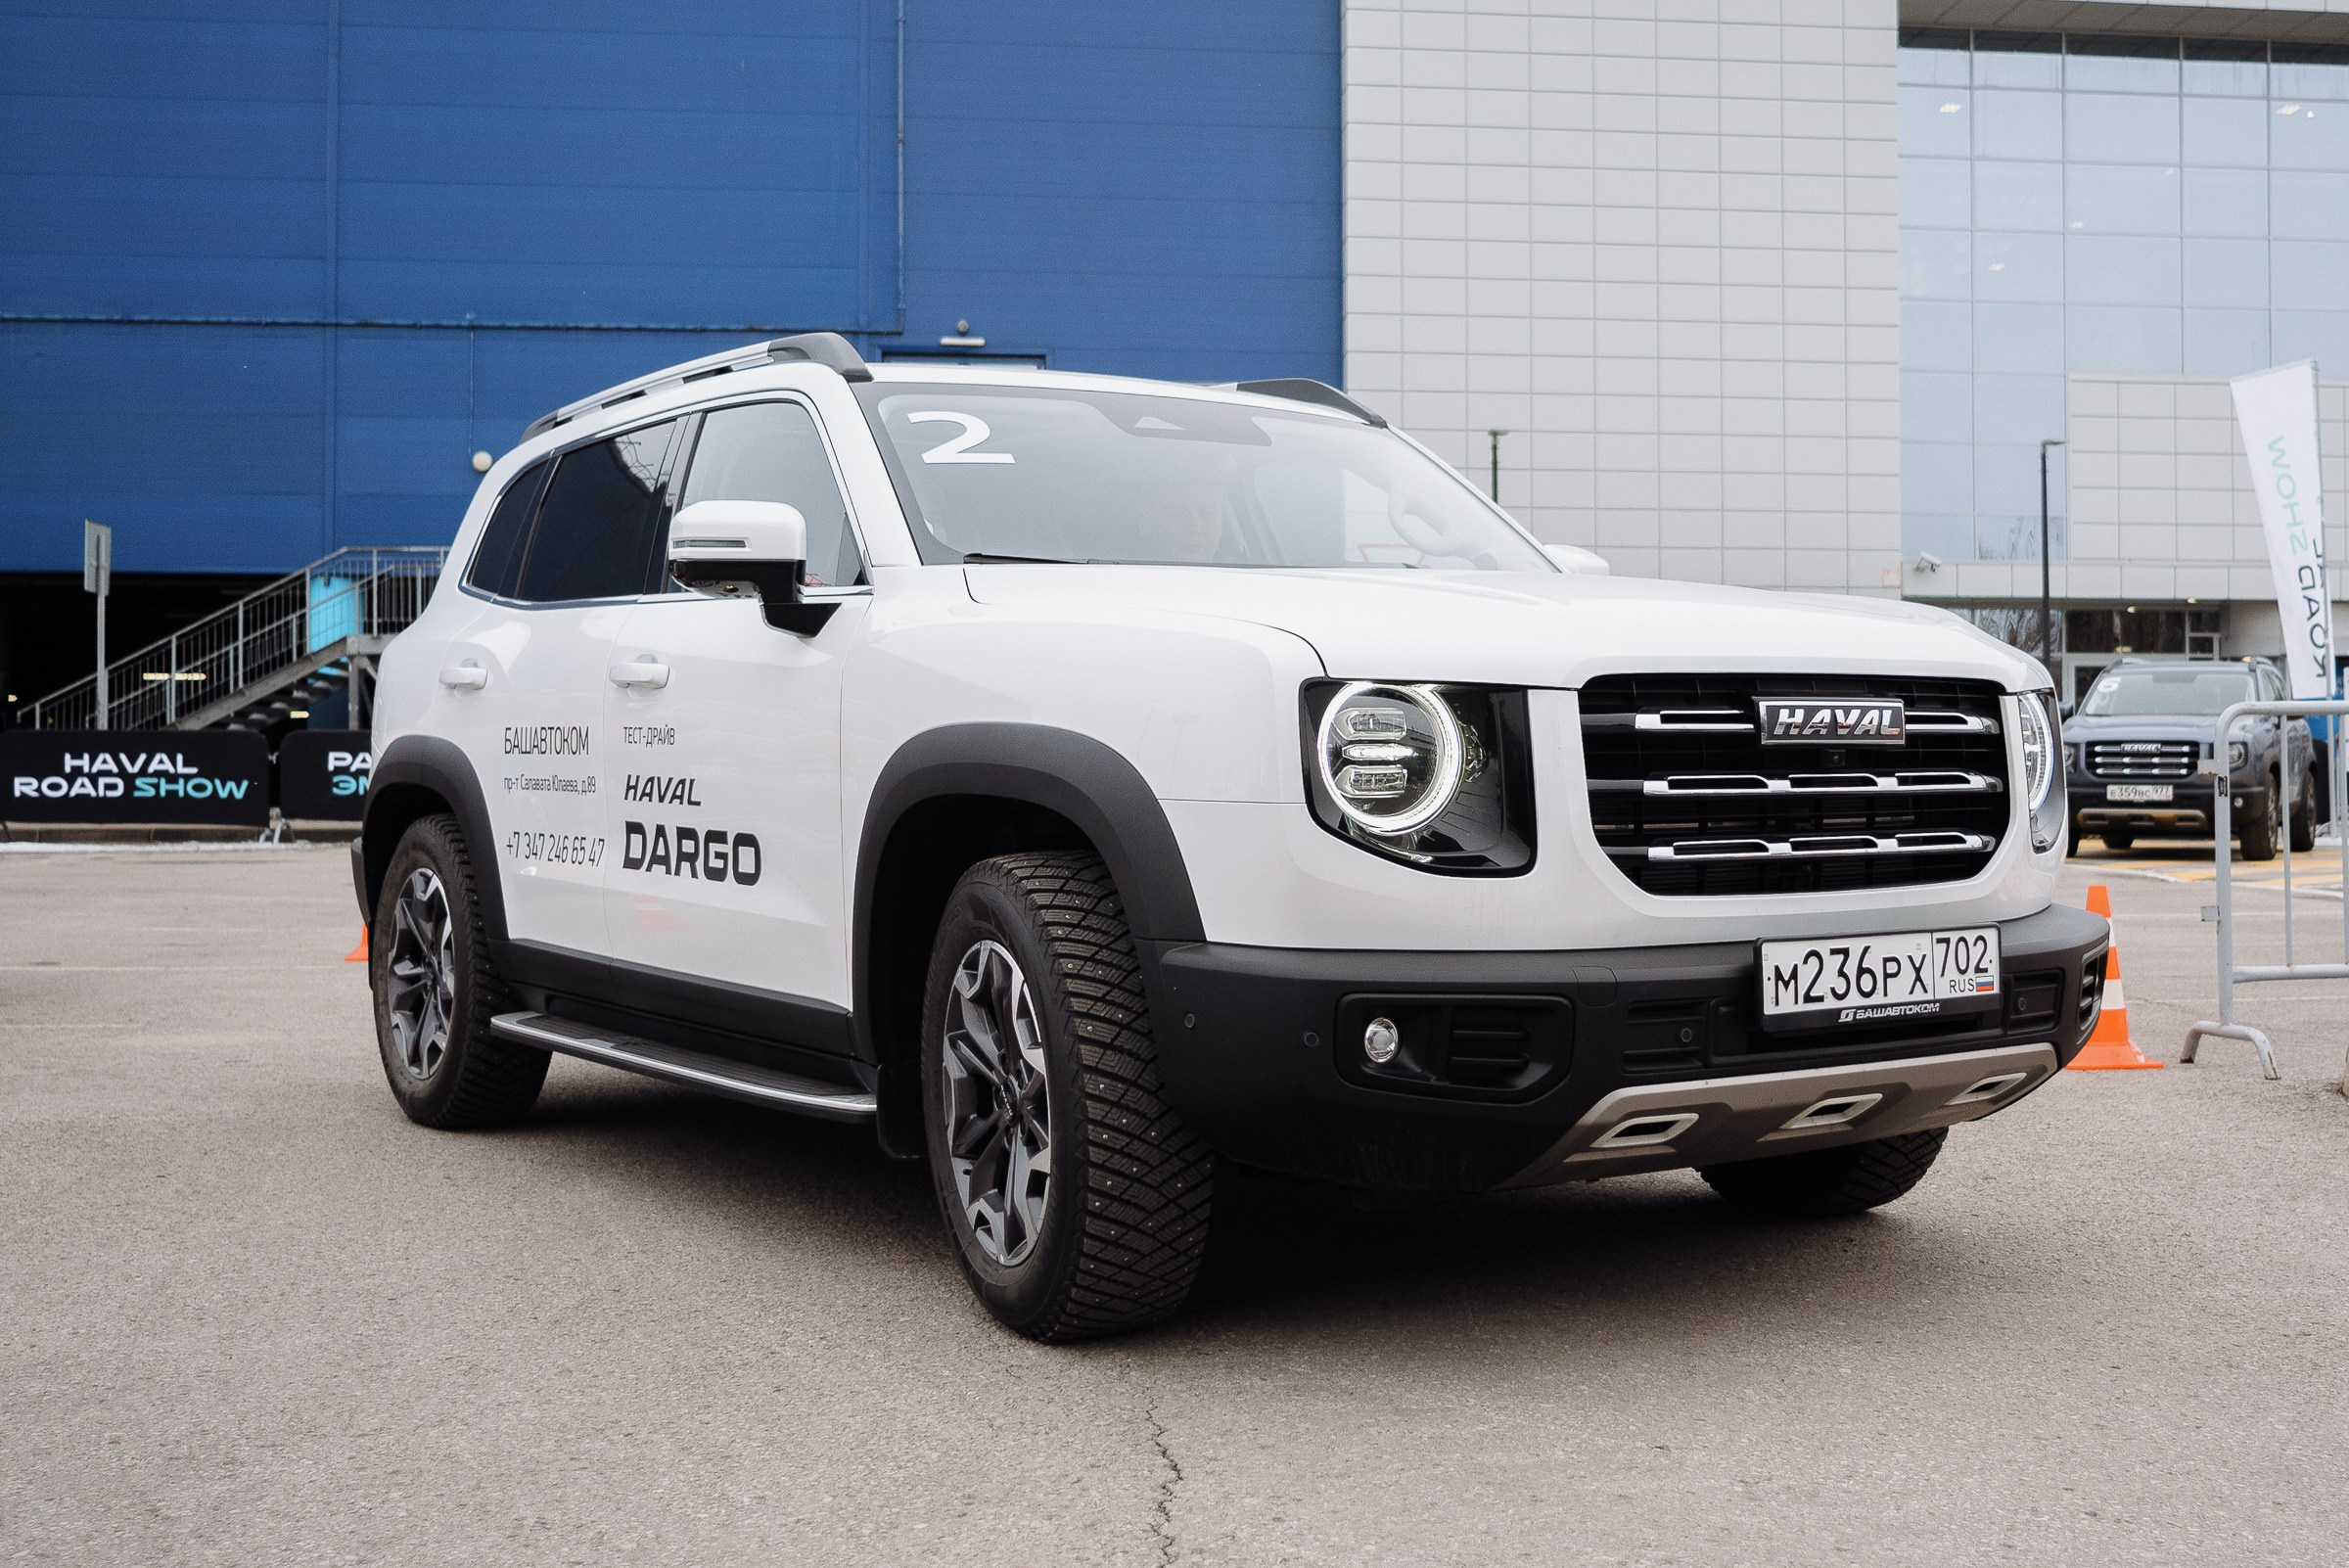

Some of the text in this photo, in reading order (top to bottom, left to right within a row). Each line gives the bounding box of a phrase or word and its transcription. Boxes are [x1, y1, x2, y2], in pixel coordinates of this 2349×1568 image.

[907, 411, 1016, 464] 2
[1773, 709, 1901, 734] HAVAL
[504, 725, 589, 756] БАШАВТОКОМ
[623, 724, 675, 748] ТЕСТ-ДРАЙВ
[64, 753, 199, 774] HAVAL
[14, 776, 249, 800] ROAD SHOW
[504, 777, 519, 794] пр-т
[624, 774, 702, 807] HAVAL
[506, 831, 605, 867] +7 347 246 65 47
[622, 820, 761, 886] DARGO
[1773, 935, 1989, 1007] М236РХ 702
[1949, 978, 1975, 993] RUS
[1856, 1002, 1940, 1019] БАШАВТОКОМ
